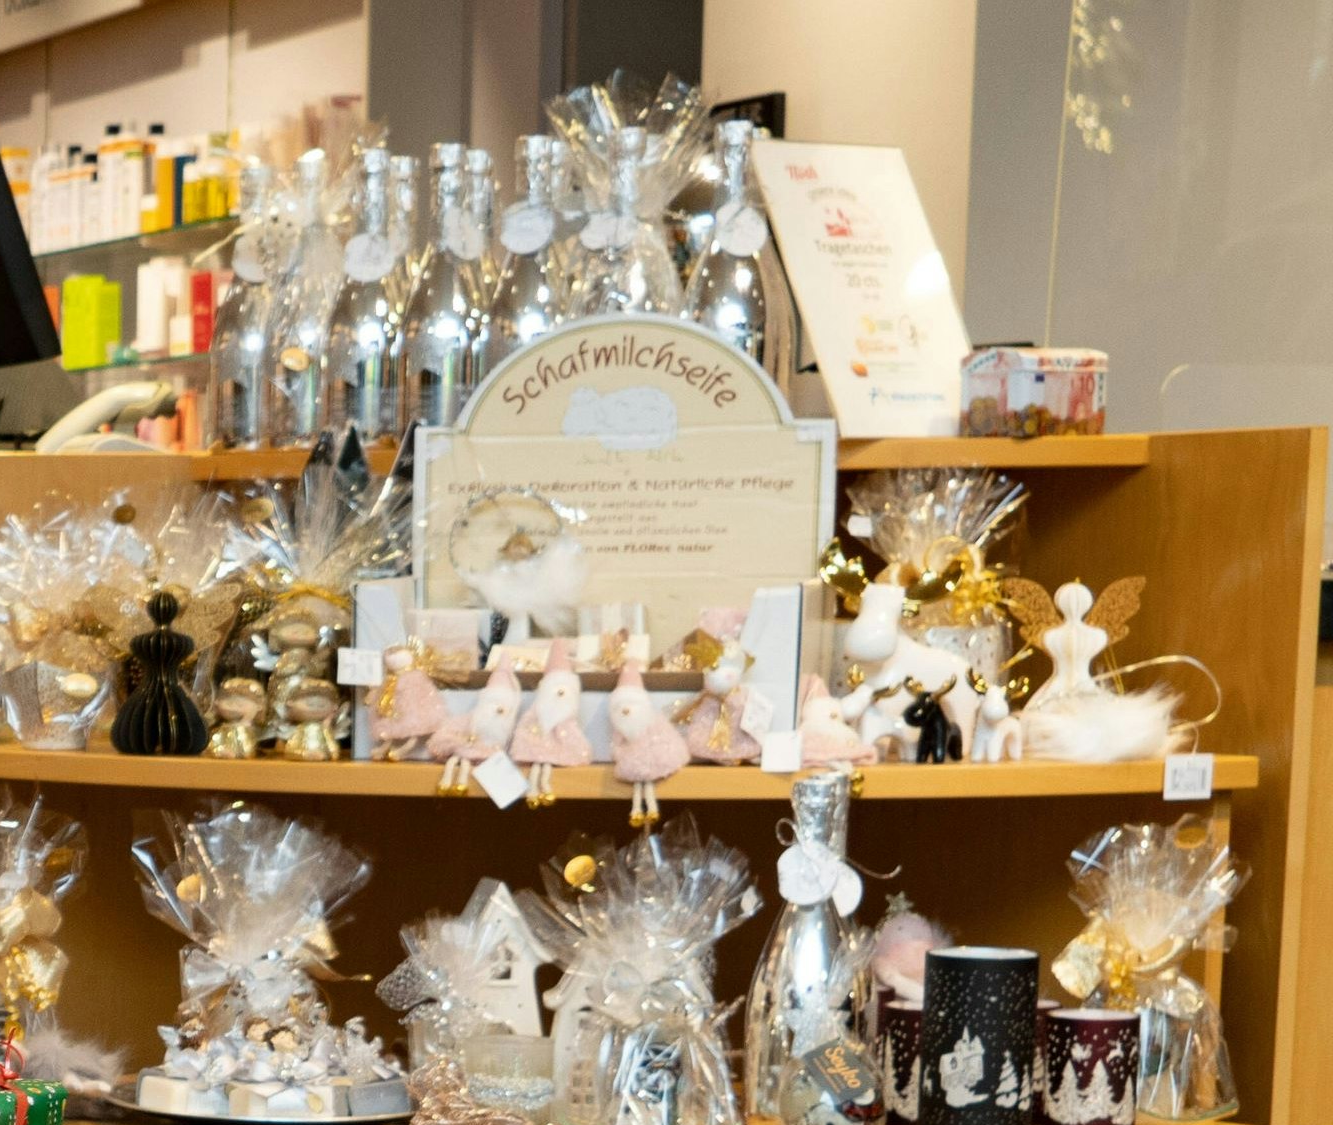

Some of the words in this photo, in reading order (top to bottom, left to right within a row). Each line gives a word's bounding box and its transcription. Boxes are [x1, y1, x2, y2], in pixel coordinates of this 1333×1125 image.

[502, 336, 737, 415] Schafmilchseife
[627, 479, 638, 491] &
[741, 476, 795, 493] Pflege
